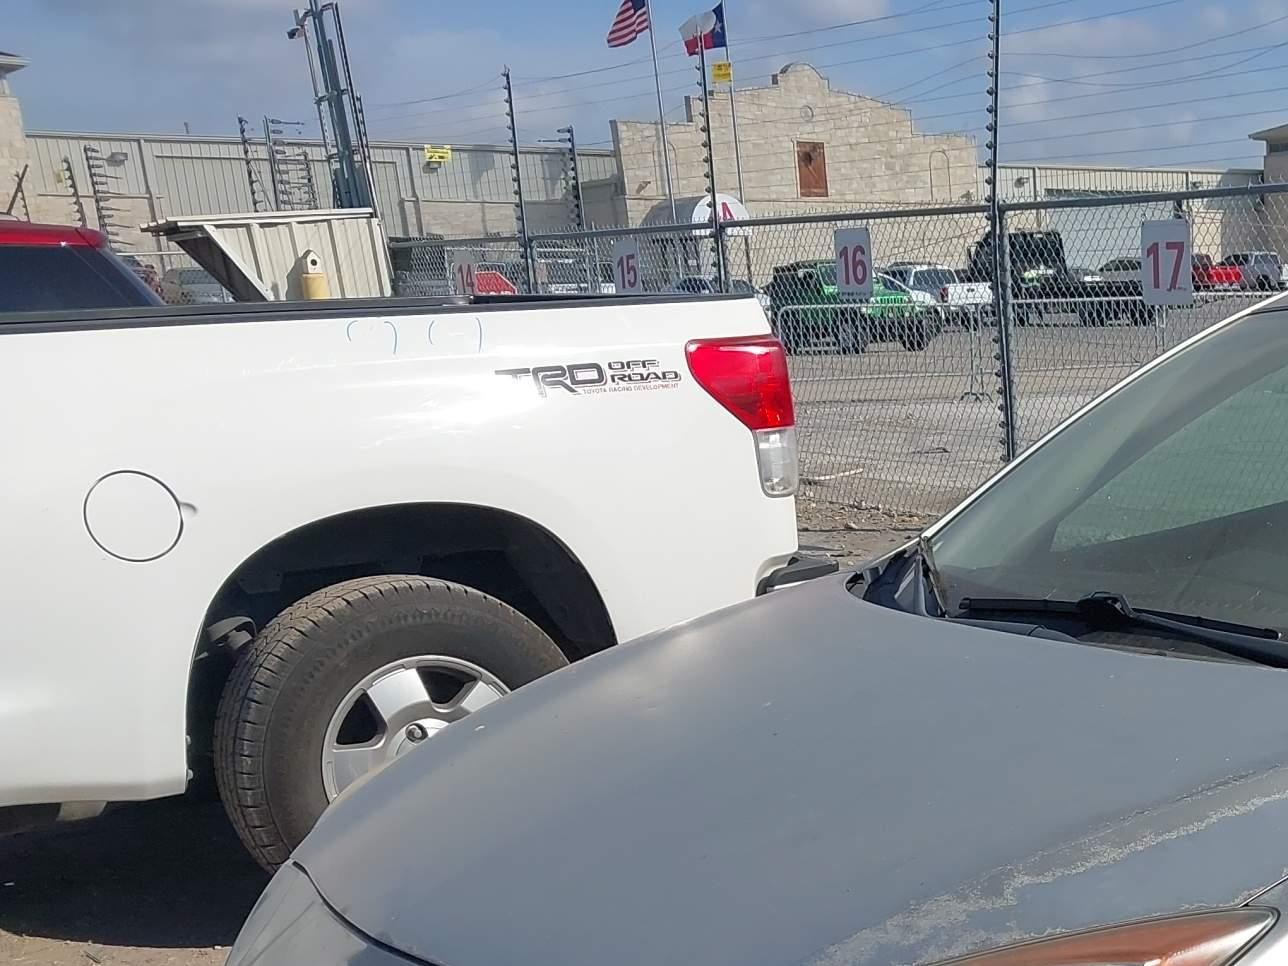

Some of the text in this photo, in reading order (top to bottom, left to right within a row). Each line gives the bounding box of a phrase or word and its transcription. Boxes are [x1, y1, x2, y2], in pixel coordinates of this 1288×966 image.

[457, 263, 475, 293] 14
[616, 253, 638, 290] 15
[839, 244, 868, 286] 16
[1146, 241, 1185, 290] 17
[494, 362, 606, 398] TRD
[607, 359, 660, 373] OFF
[609, 370, 682, 386] ROAD
